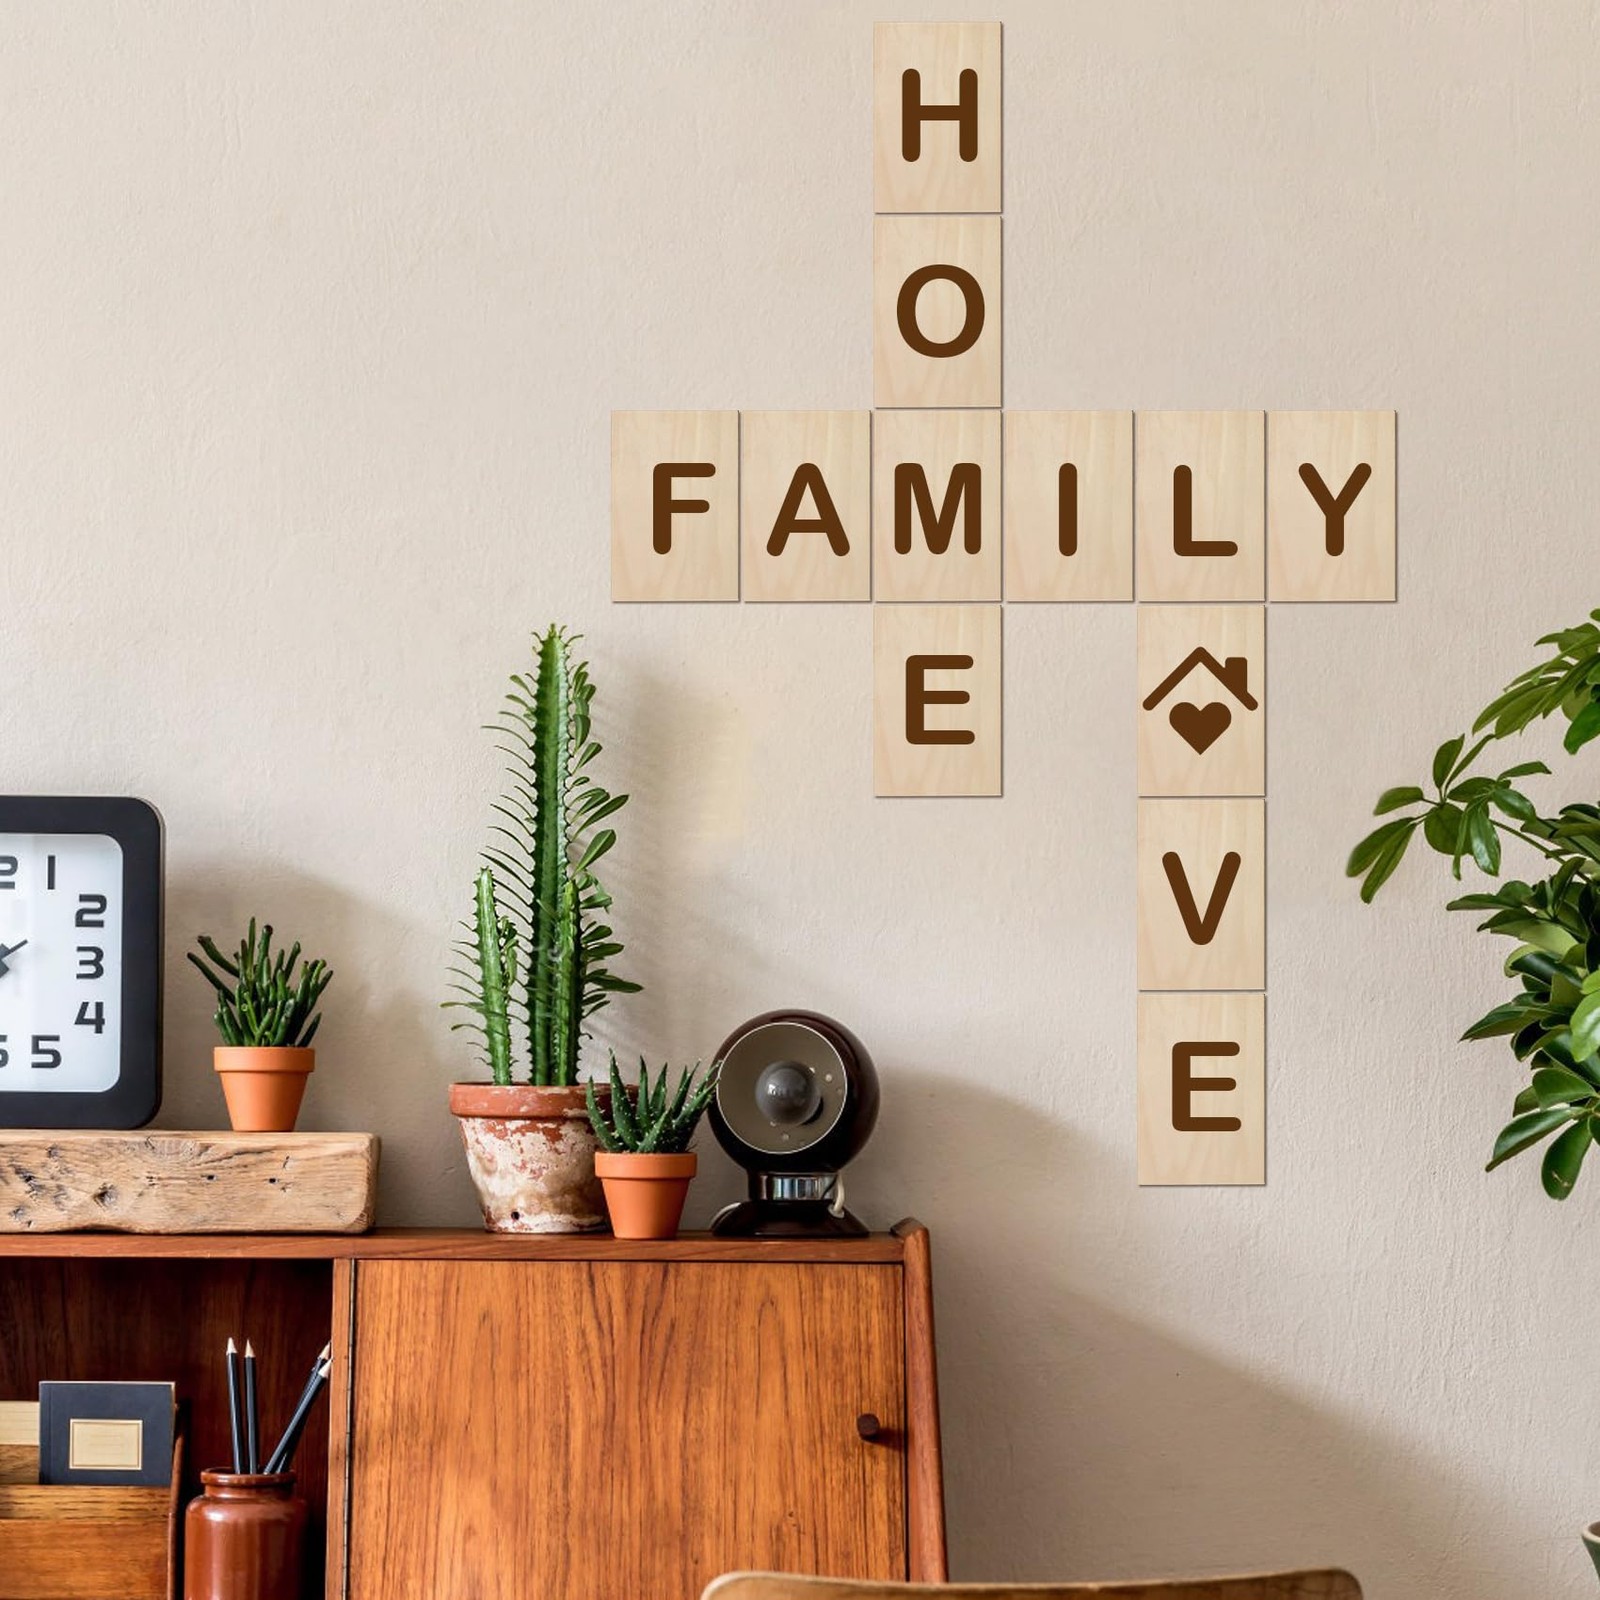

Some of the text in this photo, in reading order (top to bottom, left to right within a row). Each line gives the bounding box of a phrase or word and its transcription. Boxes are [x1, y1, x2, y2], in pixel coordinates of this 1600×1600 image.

[652, 462, 1372, 557] FAMILY
[75, 894, 107, 928] 2
[76, 946, 104, 980] 3
[74, 1001, 106, 1034] 4
[31, 1035, 62, 1069] 5
